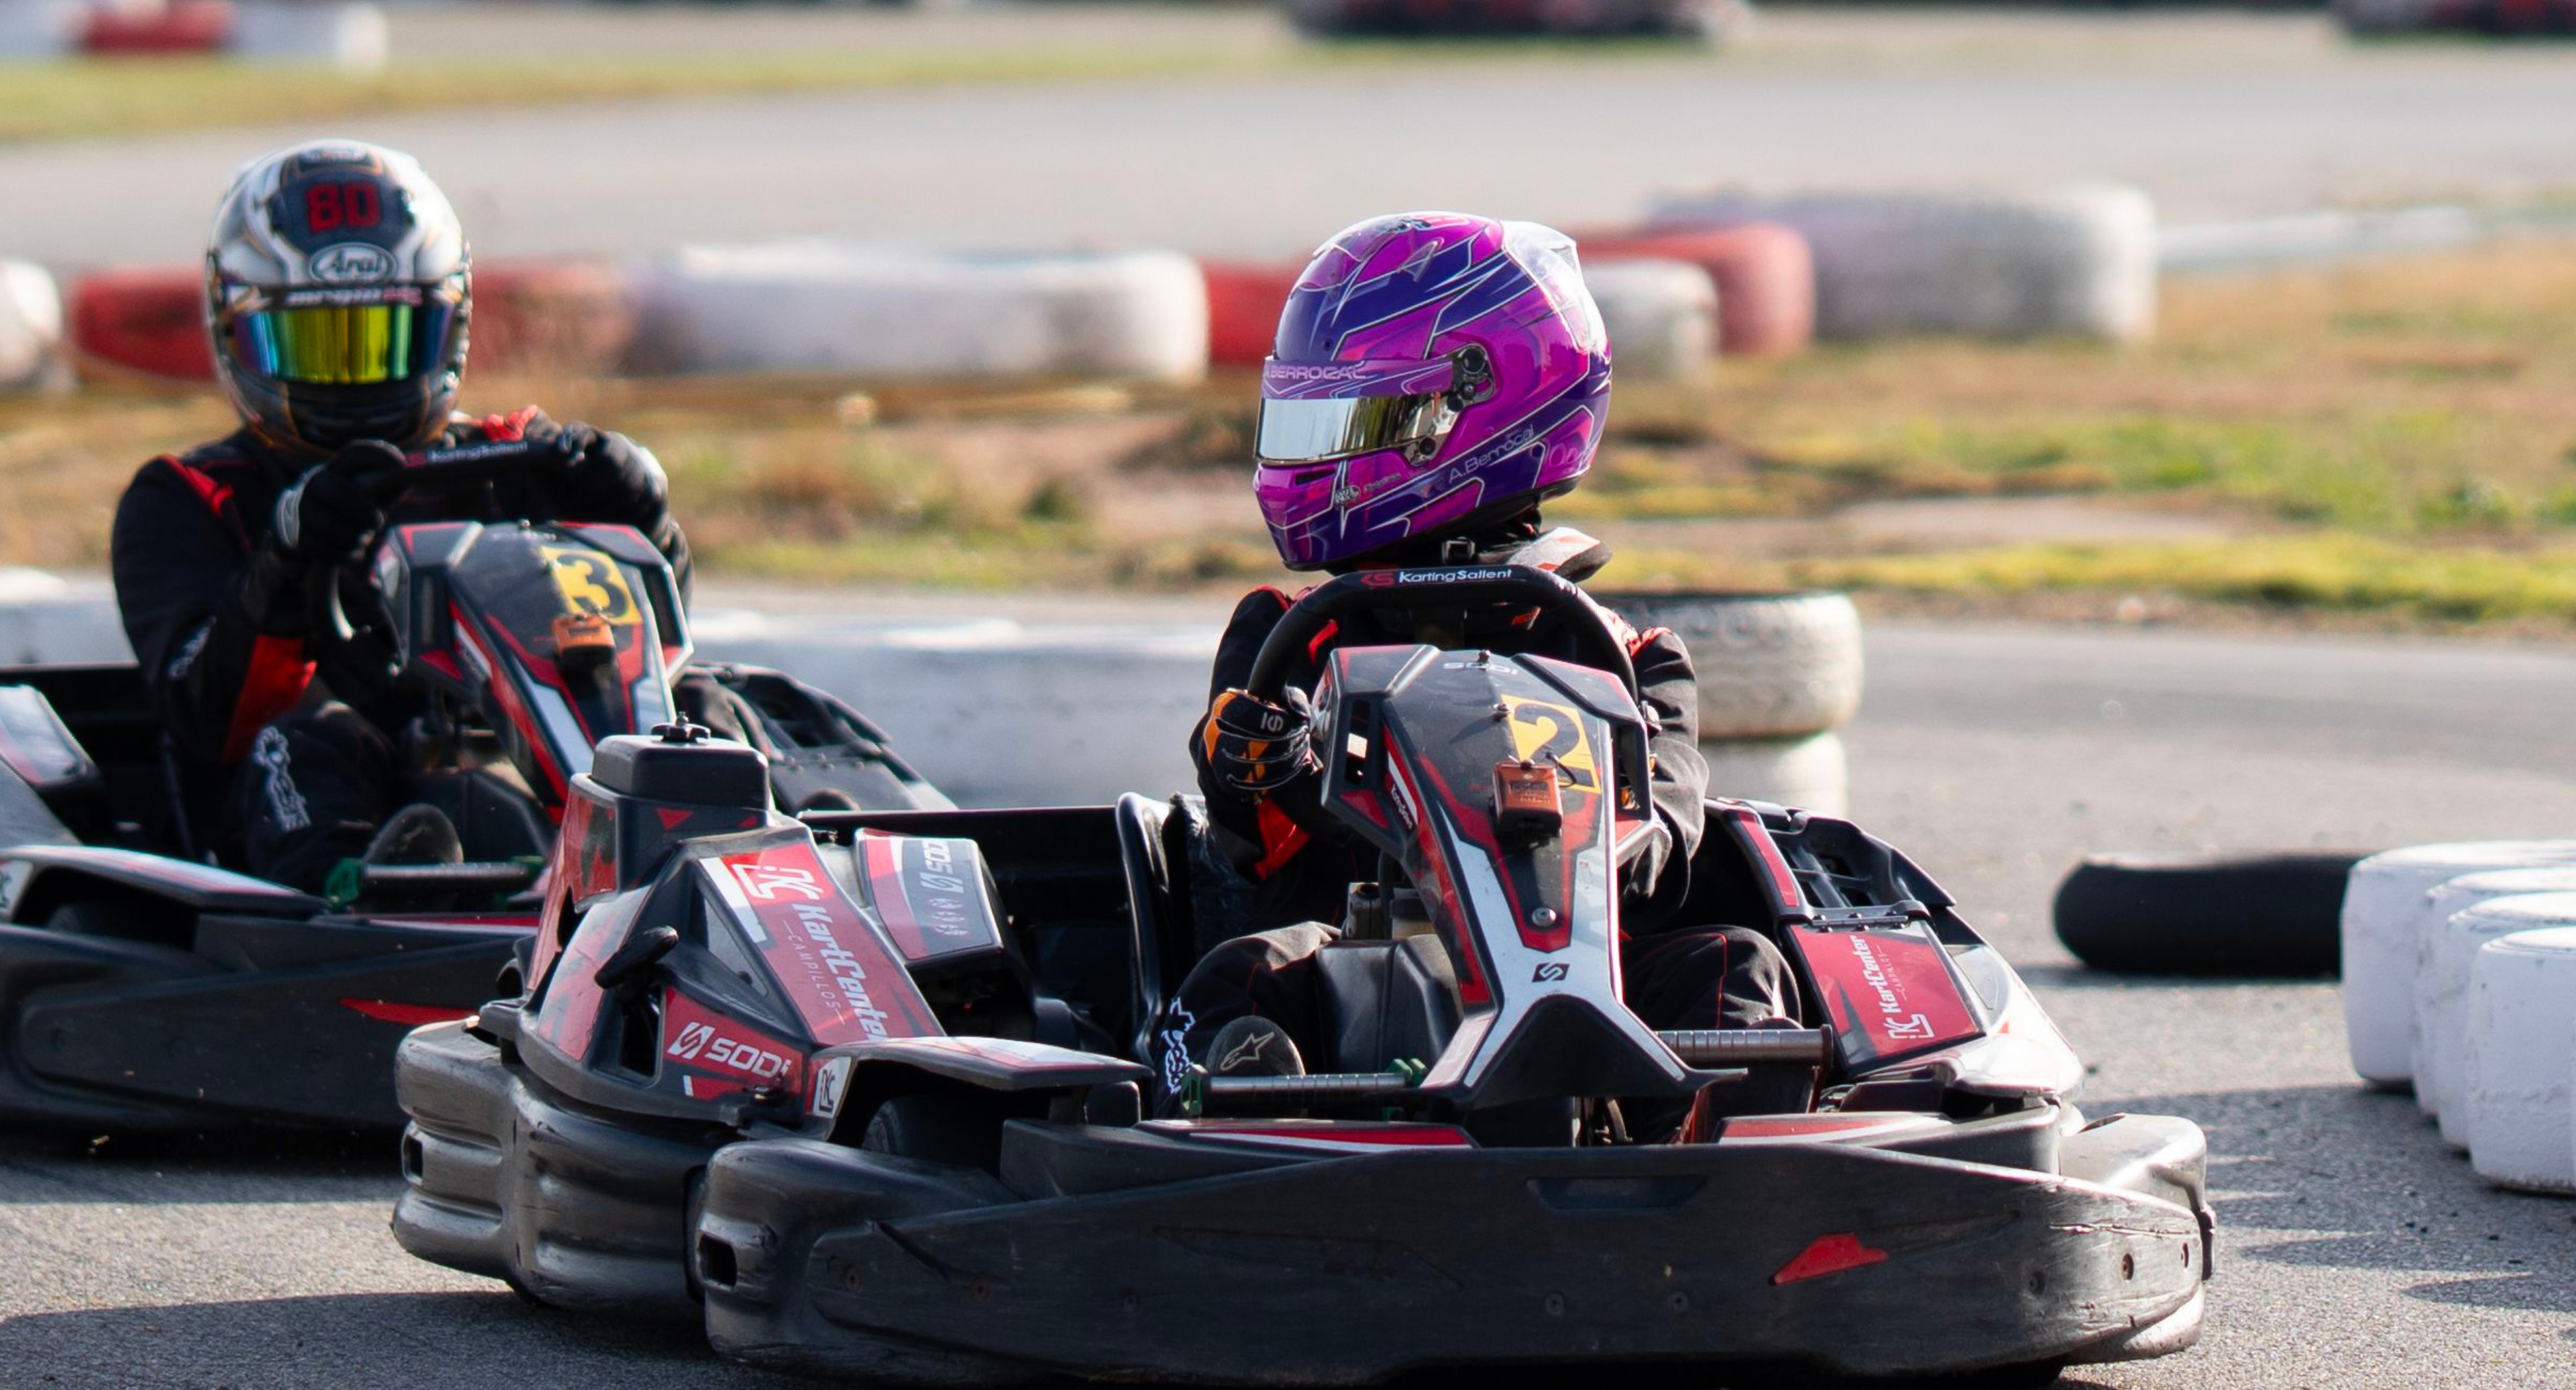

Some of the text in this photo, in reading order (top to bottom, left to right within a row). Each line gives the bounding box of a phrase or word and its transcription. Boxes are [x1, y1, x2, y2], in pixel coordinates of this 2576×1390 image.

[305, 182, 382, 232] 80
[311, 247, 385, 275] Arai
[1448, 424, 1534, 484] A.Berrocal
[556, 553, 629, 618] 3
[1399, 569, 1513, 584] KartingSallent
[1513, 703, 1595, 788] 2
[922, 841, 955, 875] SOD
[787, 934, 843, 1010] CAMPILLOS
[1849, 934, 1902, 1013] KartCenter
